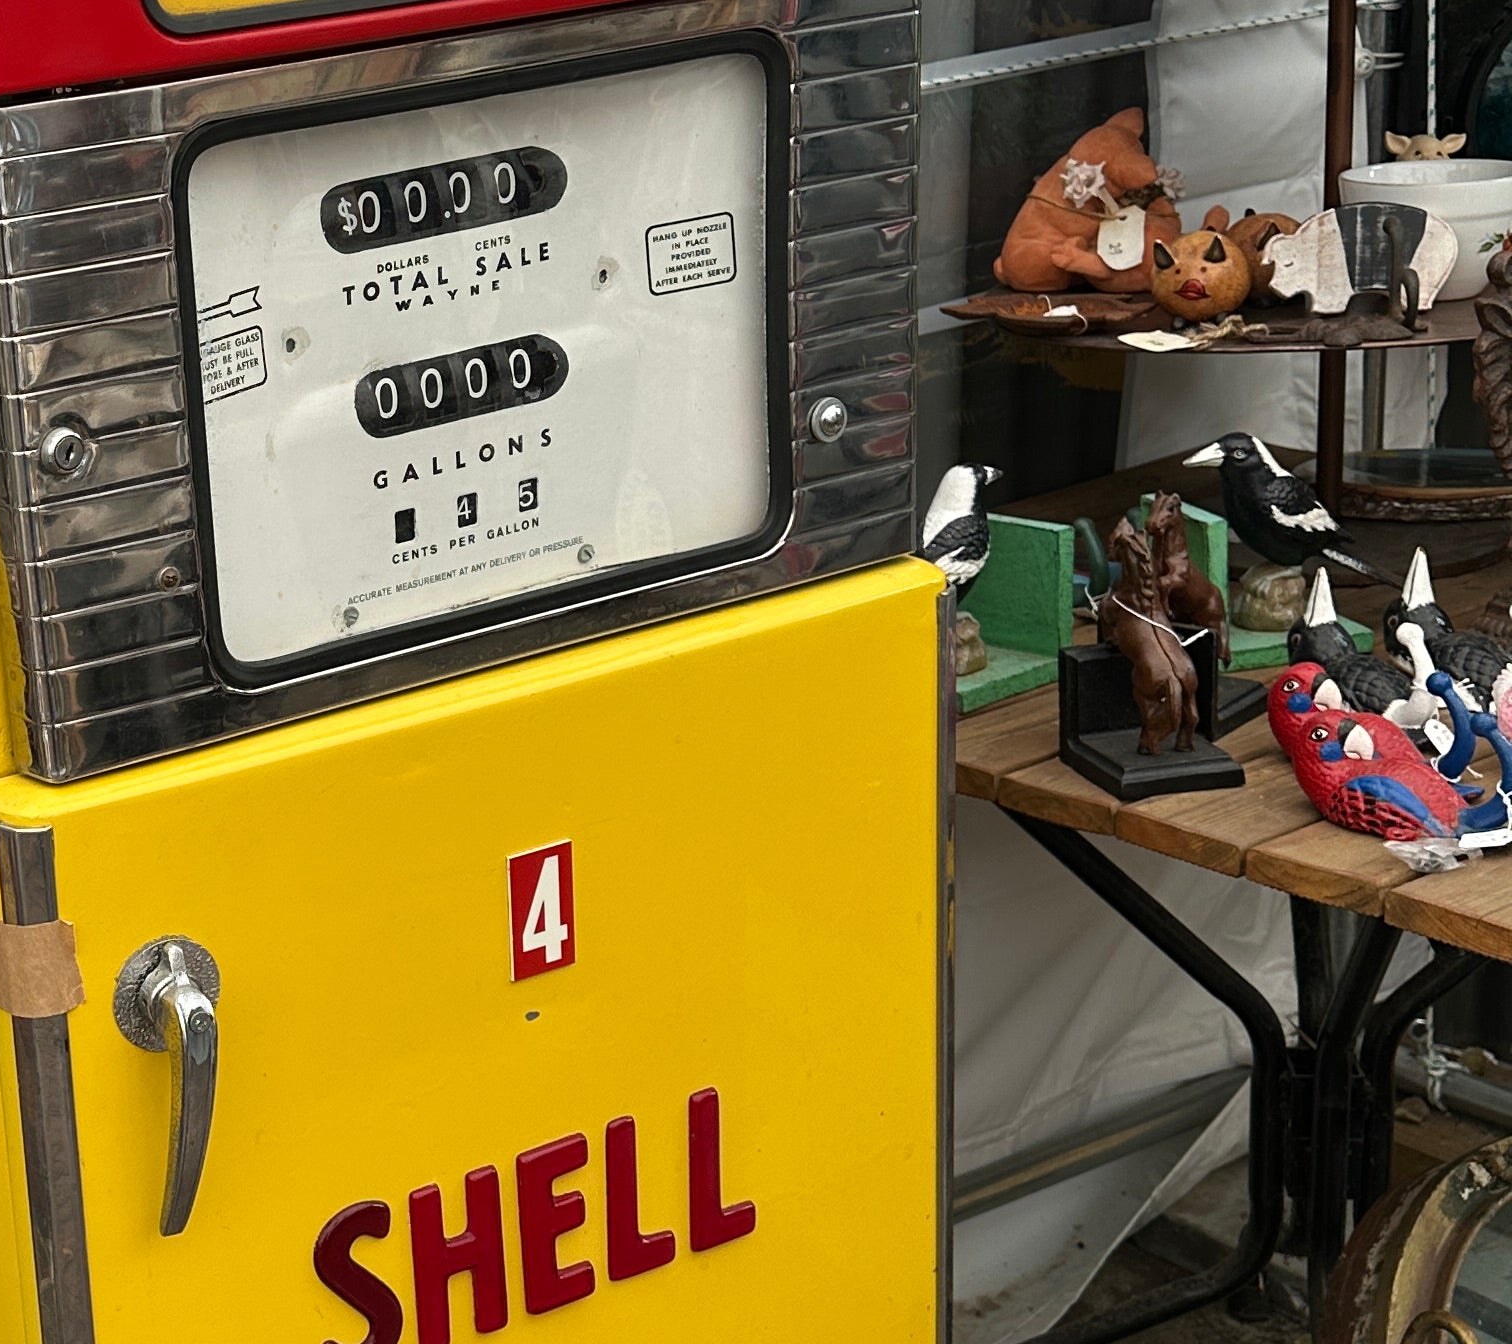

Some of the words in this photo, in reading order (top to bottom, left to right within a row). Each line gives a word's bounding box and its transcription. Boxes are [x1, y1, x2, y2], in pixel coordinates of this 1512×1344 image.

[652, 231, 678, 243] HANG
[681, 228, 693, 237] UP
[696, 222, 727, 235] NOZZLE
[475, 235, 511, 252] CENTS
[671, 242, 681, 250] IN
[685, 237, 709, 247] PLACE
[671, 247, 711, 261] PROVIDED
[342, 267, 449, 305] TOTAL
[476, 242, 550, 276] SALE
[376, 255, 430, 274] DOLLARS
[665, 258, 718, 274] IMMEDIATELY
[655, 277, 678, 288] AFTER
[682, 272, 703, 282] EACH
[395, 280, 500, 312] WAYNE
[234, 332, 260, 347] GLASS
[222, 354, 232, 364] BE
[235, 347, 254, 361] FULL
[236, 357, 260, 373] AFTER
[210, 375, 245, 395] DELIVERY
[373, 428, 552, 490] GALLONS
[392, 544, 438, 565] CENTS
[449, 534, 476, 550] PER
[487, 516, 540, 540] GALLON
[347, 586, 393, 606] ACCURATE
[395, 569, 458, 593] MEASUREMENT
[459, 566, 469, 577] AT
[471, 561, 488, 574] ANY
[489, 551, 527, 569] DELIVERY
[529, 547, 541, 558] OR
[542, 535, 585, 554] PRESSURE
[521, 853, 569, 964] 4
